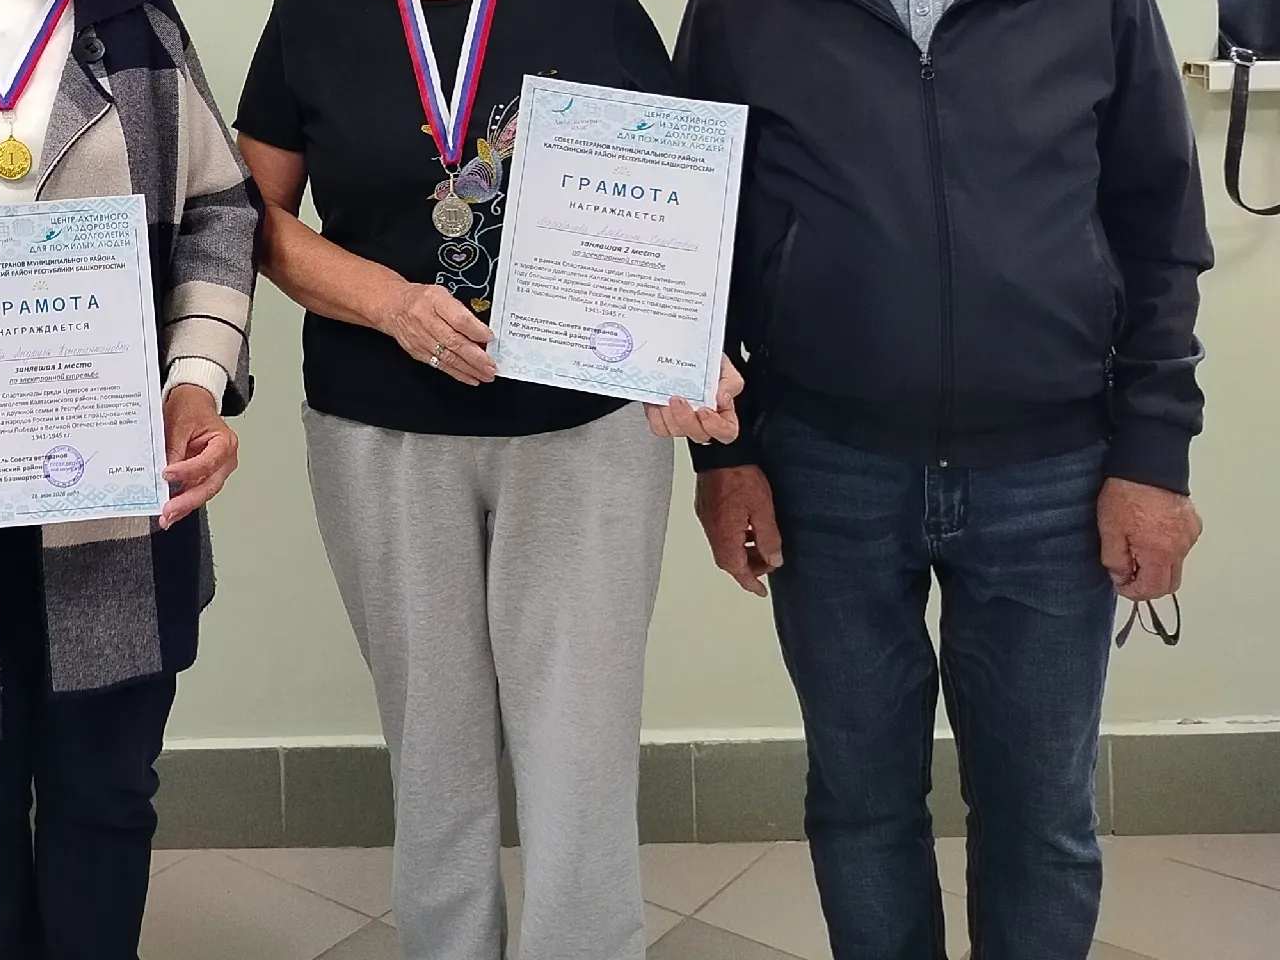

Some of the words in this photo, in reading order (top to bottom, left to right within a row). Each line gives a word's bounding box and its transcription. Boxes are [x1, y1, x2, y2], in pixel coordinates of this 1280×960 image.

[643, 109, 671, 121] ЦЕНТР
[673, 114, 726, 128] АКТИВНОГО
[664, 129, 724, 145] ДОЛГОЛЕТИЯ
[668, 122, 725, 137] ЗДОРОВОГО
[553, 136, 573, 144] СОВЕТ
[574, 139, 611, 150] ВЕТЕРАНОВ
[611, 144, 676, 160] МУНИЦИПАЛЬНОГО
[677, 153, 706, 163] РАЙОНА
[616, 131, 635, 141] ДЛЯ
[638, 134, 686, 147] ПОЖИЛЫХ
[688, 140, 724, 154] ЛЮДЕЙ
[594, 149, 616, 159] РАЙОН
[617, 153, 660, 165] РЕСПУБЛИКИ
[661, 160, 715, 173] БАШКОРТОСТАН
[561, 174, 681, 205] ГРАМОТА
[50, 216, 76, 225] ЦЕНТР
[78, 212, 128, 223] АКТИВНОГО
[569, 200, 666, 223] НАГРАЖДАЕТСЯ
[75, 221, 128, 232] ЗДОРОВОГО
[72, 229, 129, 241] ДОЛГОЛЕТИЯ
[28, 244, 46, 253] ДЛЯ
[49, 241, 94, 251] ПОЖИЛЫХ
[96, 237, 130, 249] ЛЮДЕЙ
[579, 240, 623, 252] занявшая
[630, 248, 661, 258] место
[26, 256, 88, 268] МУНИЦИПАЛЬНОГО
[89, 253, 115, 262] РАЙОНА
[11, 267, 32, 276] РАЙОН
[33, 266, 74, 275] РЕСПУБЛИКИ
[75, 262, 125, 272] БАШКОРТОСТАН
[509, 312, 557, 327] Председатель
[558, 320, 582, 330] Совета
[14, 364, 56, 373] занявшая
[56, 362, 63, 370] 1
[63, 361, 92, 369] место
[9, 454, 32, 463] Совета
